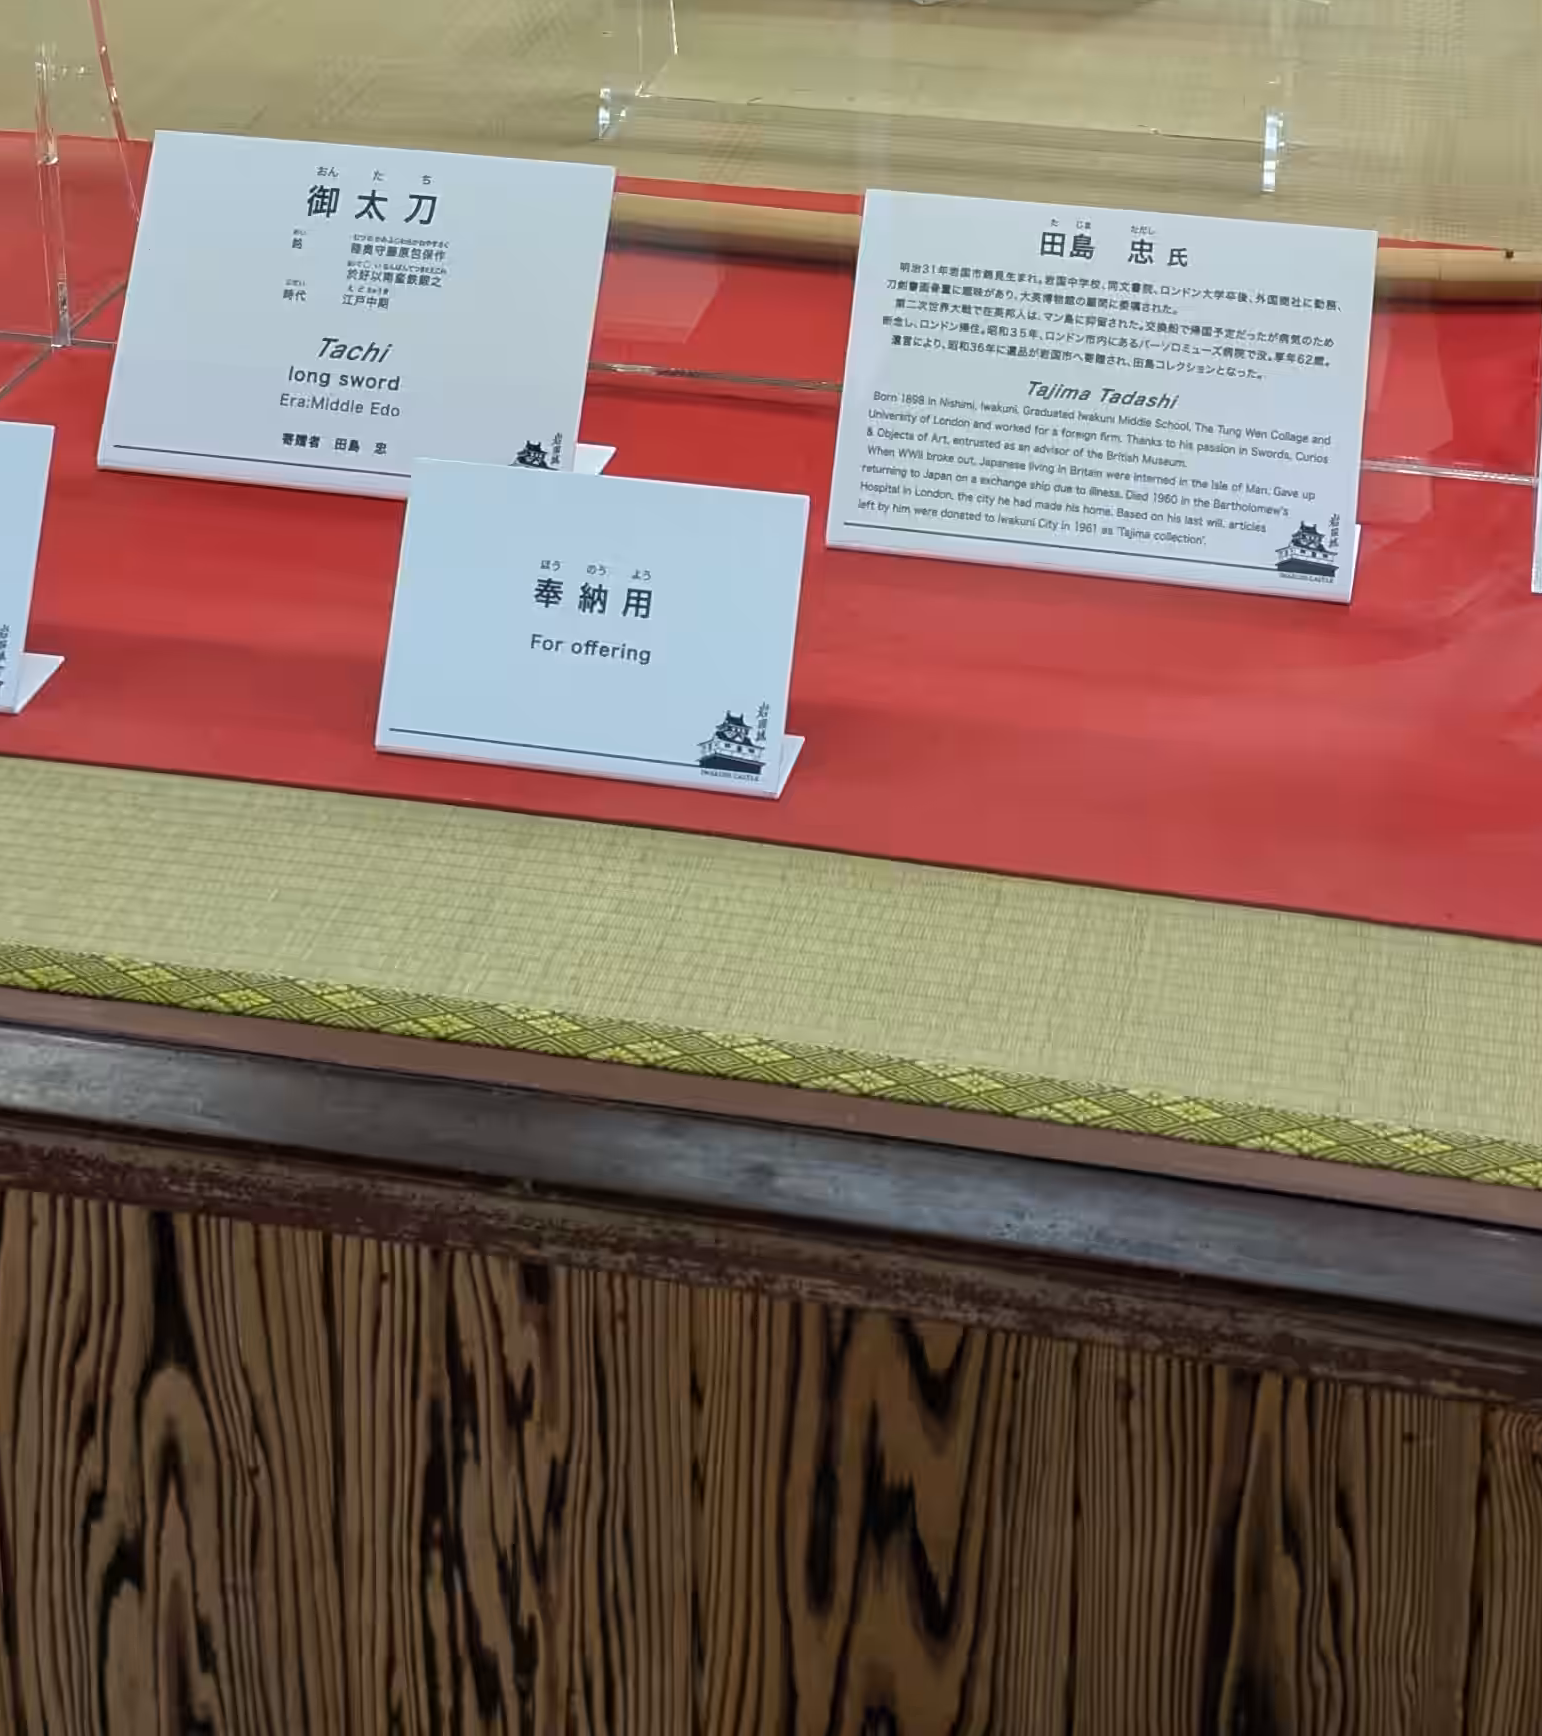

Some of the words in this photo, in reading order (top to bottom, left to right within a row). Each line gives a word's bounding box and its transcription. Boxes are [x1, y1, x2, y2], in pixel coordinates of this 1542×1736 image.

[306, 184, 438, 226] 御太刀
[1039, 231, 1097, 261] 田島
[1166, 247, 1188, 268] 氏
[317, 337, 394, 364] Tachi
[288, 365, 332, 388] long
[338, 373, 401, 392] sword
[1027, 380, 1092, 401] Tajima
[1099, 387, 1180, 410] Tadashi
[370, 401, 401, 417] Edo
[872, 390, 898, 403] Born
[927, 396, 937, 407] in
[1022, 405, 1076, 420] Graduated
[1077, 410, 1116, 425] Iwakuni
[1118, 414, 1153, 428] Middle
[1194, 421, 1215, 434] The
[1216, 423, 1243, 439] Tung
[1311, 435, 1332, 446] and
[876, 427, 915, 441] Objects
[916, 431, 929, 442] of
[952, 437, 1002, 450] entrusted
[1032, 443, 1071, 456] advisor
[1072, 447, 1085, 458] of
[1086, 448, 1104, 460] the
[1106, 449, 1140, 464] British
[919, 413, 932, 425] of
[932, 415, 971, 429] London
[972, 420, 993, 431] and
[994, 423, 1032, 434] worked
[1034, 424, 1051, 436] for
[1126, 433, 1164, 448] Thanks
[1165, 438, 1177, 449] to
[1178, 439, 1194, 451] his
[1196, 442, 1236, 455] passion
[1238, 445, 1249, 456] in
[1294, 451, 1329, 465] Curios
[867, 444, 895, 459] When
[925, 451, 955, 464] broke
[978, 456, 1027, 471] Japanese
[1028, 460, 1055, 475] living
[1057, 463, 1067, 475] in
[1069, 464, 1103, 479] Britain
[1106, 471, 1131, 481] were
[1178, 476, 1188, 487] in
[1189, 478, 1209, 489] the
[1210, 479, 1229, 491] Isle
[1230, 482, 1244, 493] of
[1272, 485, 1300, 499] Gave
[1301, 491, 1316, 502] up
[909, 468, 921, 479] to
[922, 468, 953, 483] Japan
[954, 473, 969, 483] on
[1029, 480, 1052, 492] ship
[1052, 483, 1074, 494] due
[1074, 484, 1087, 496] to
[1124, 489, 1150, 503] Died
[1153, 491, 1179, 505] 1960
[1180, 495, 1191, 506] in
[1192, 497, 1211, 509] the
[857, 498, 876, 511] left
[877, 501, 891, 516] by
[892, 503, 912, 516] him
[913, 507, 939, 518] were
[940, 507, 982, 522] donated
[983, 512, 996, 523] to
[996, 512, 1037, 527] Iwakuni
[1037, 517, 1059, 532] City
[1060, 519, 1071, 531] in
[1075, 520, 1097, 534] 1961
[859, 480, 901, 495] Hospital
[902, 484, 913, 496] in
[957, 491, 974, 503] the
[976, 493, 996, 507] city
[997, 495, 1011, 506] he
[1012, 496, 1033, 509] had
[1034, 500, 1063, 512] made
[1065, 502, 1081, 513] his
[1115, 507, 1148, 521] Based
[1149, 512, 1164, 522] on
[1166, 512, 1182, 524] his
[1184, 515, 1204, 527] last
[1228, 520, 1267, 533] articles
[533, 577, 653, 620] 奉納用
[530, 633, 566, 652] For
[570, 639, 652, 666] offering
